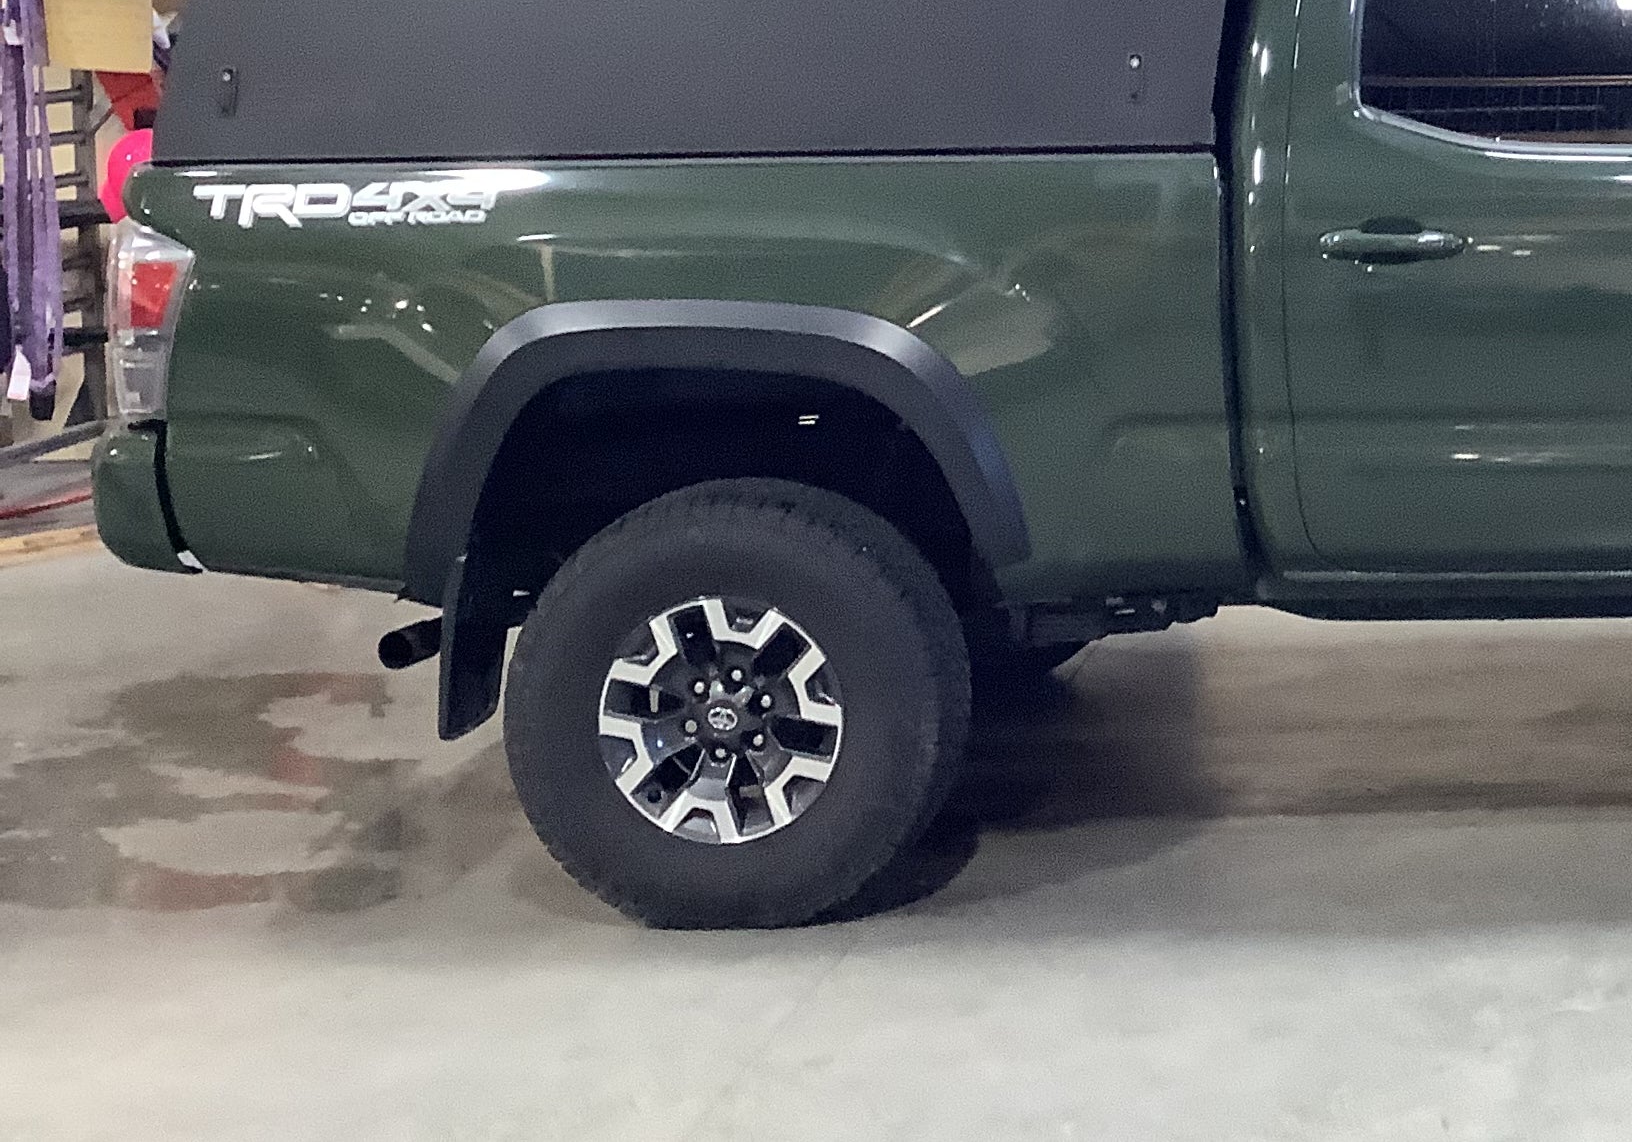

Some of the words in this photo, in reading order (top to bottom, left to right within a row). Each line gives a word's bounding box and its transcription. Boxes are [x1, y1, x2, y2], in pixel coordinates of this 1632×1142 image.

[193, 183, 352, 229] TRD
[348, 210, 405, 227] OFF
[407, 209, 487, 226] ROAD
